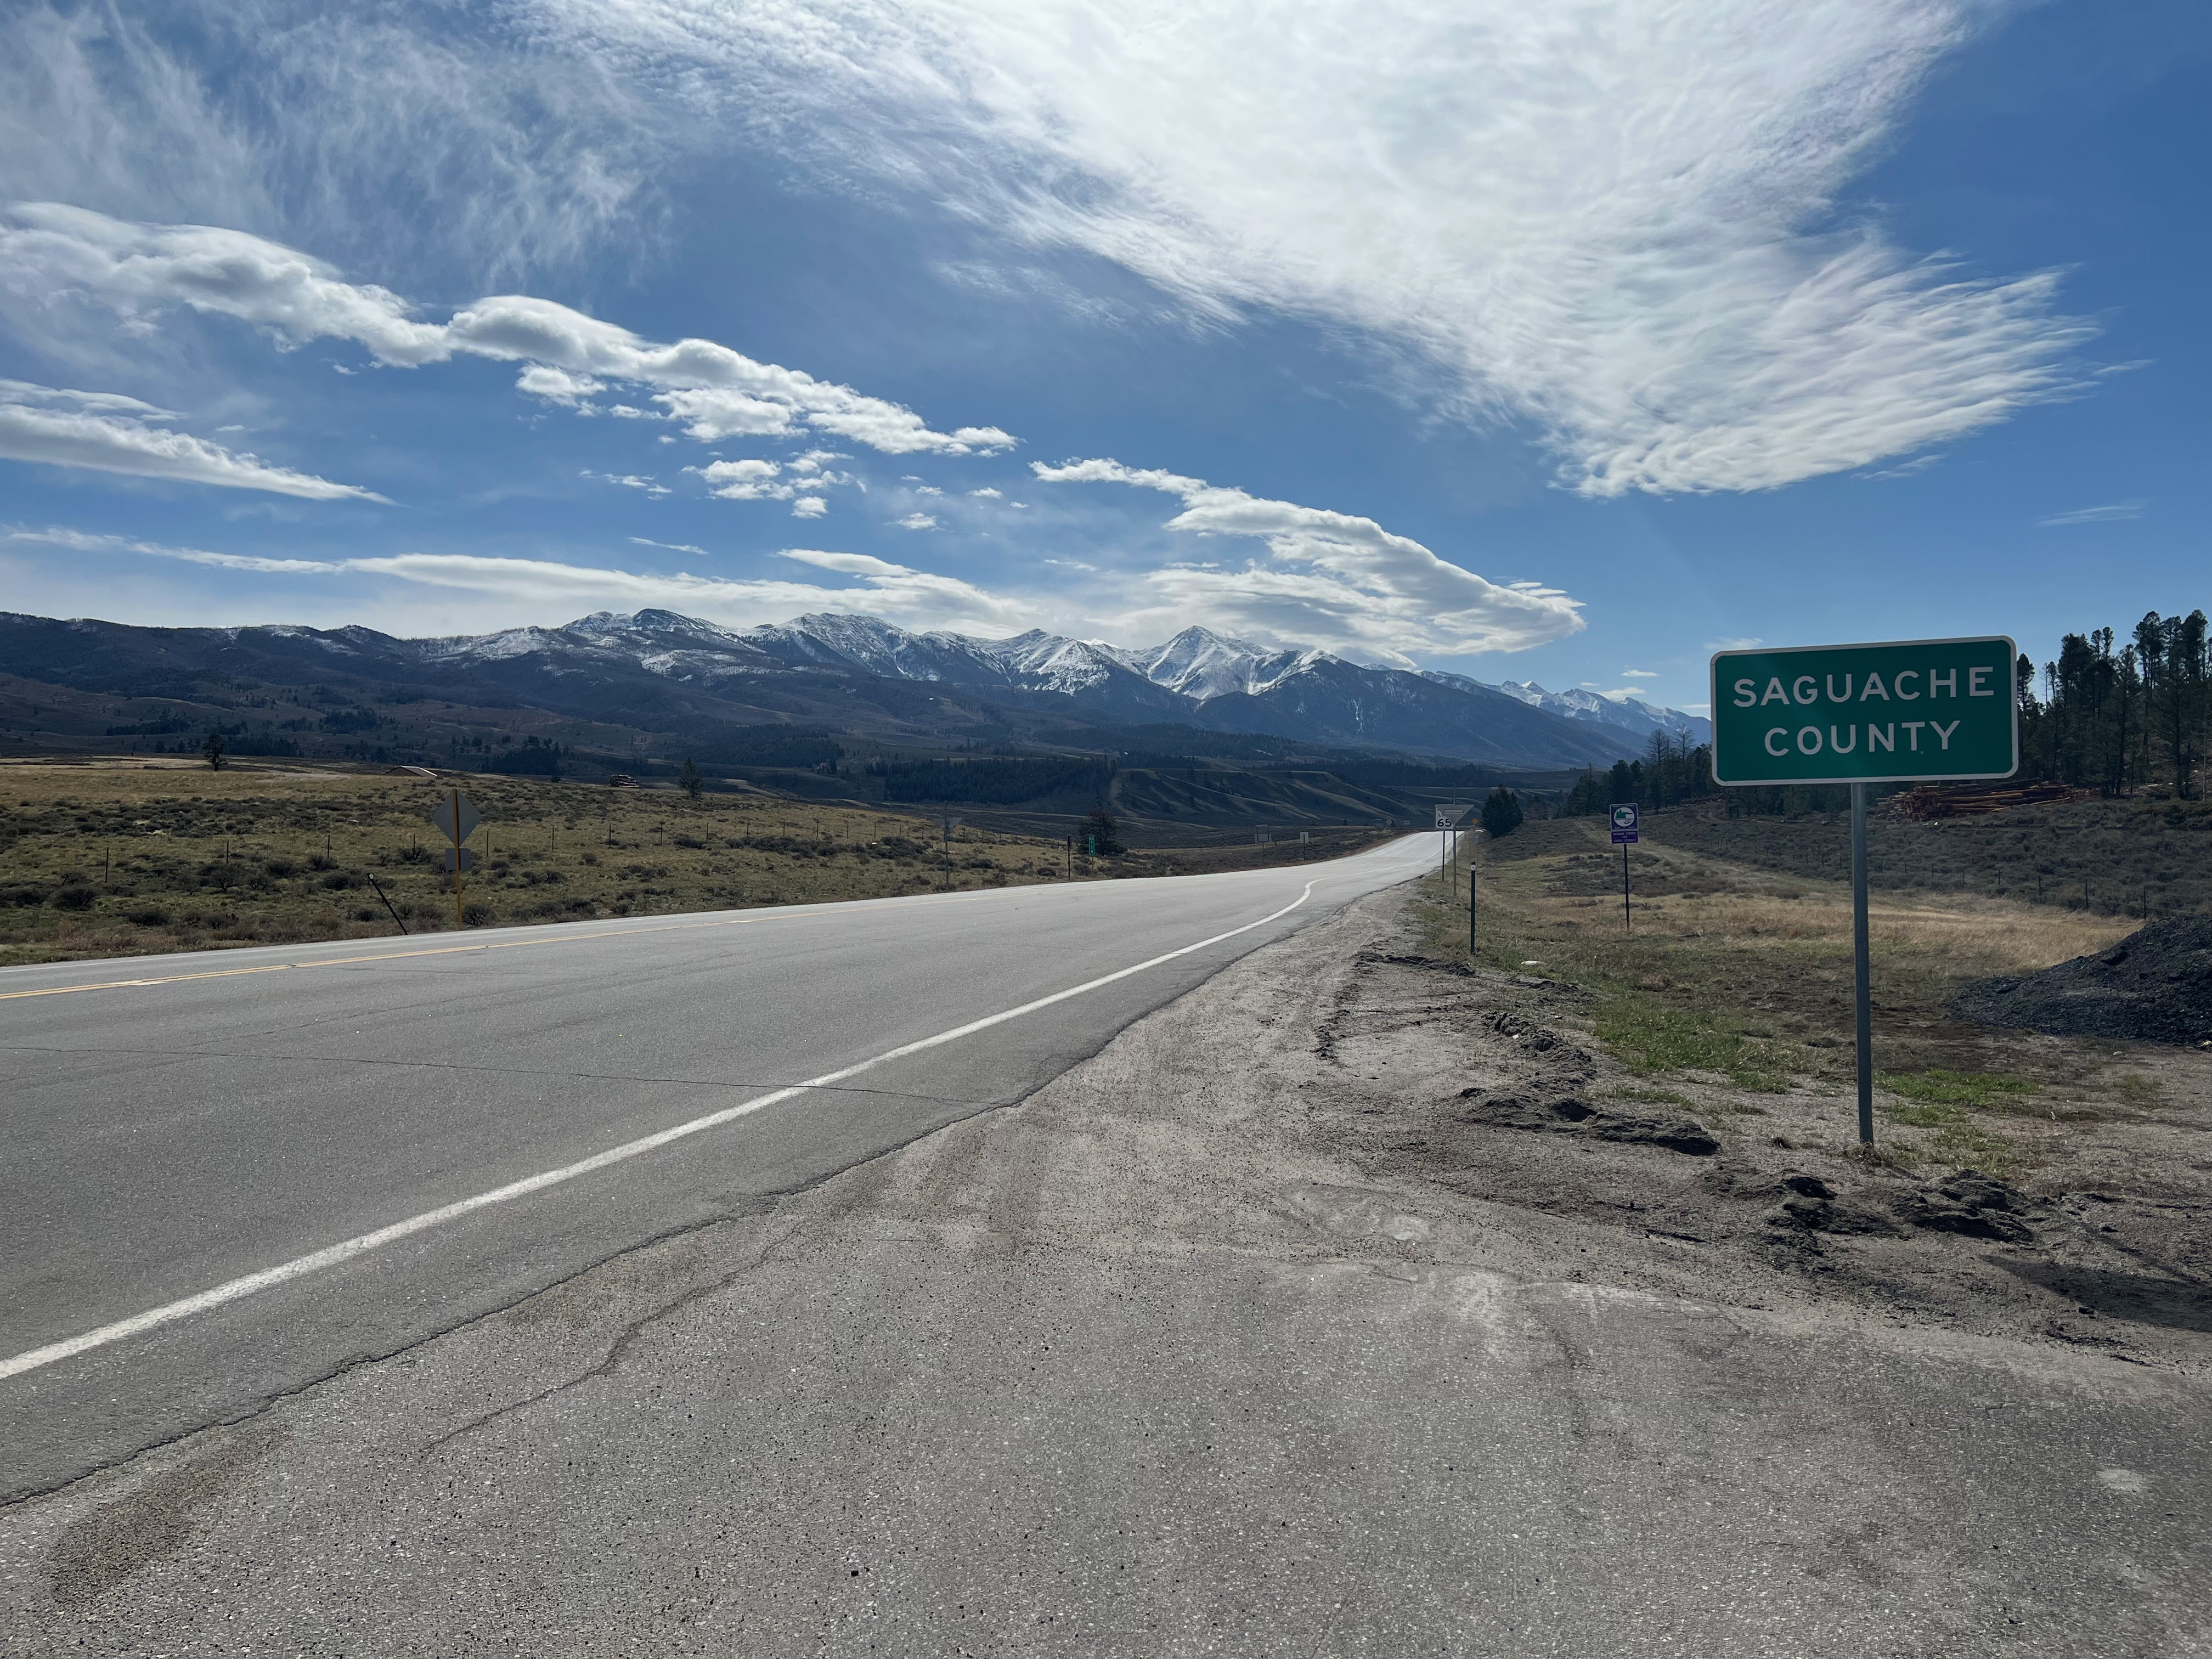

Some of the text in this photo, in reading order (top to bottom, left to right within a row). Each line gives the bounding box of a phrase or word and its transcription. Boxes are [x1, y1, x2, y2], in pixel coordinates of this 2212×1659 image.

[1733, 666, 1995, 708] SAGUACHE
[1764, 720, 1961, 757] COUNTY
[1437, 819, 1452, 827] 65
